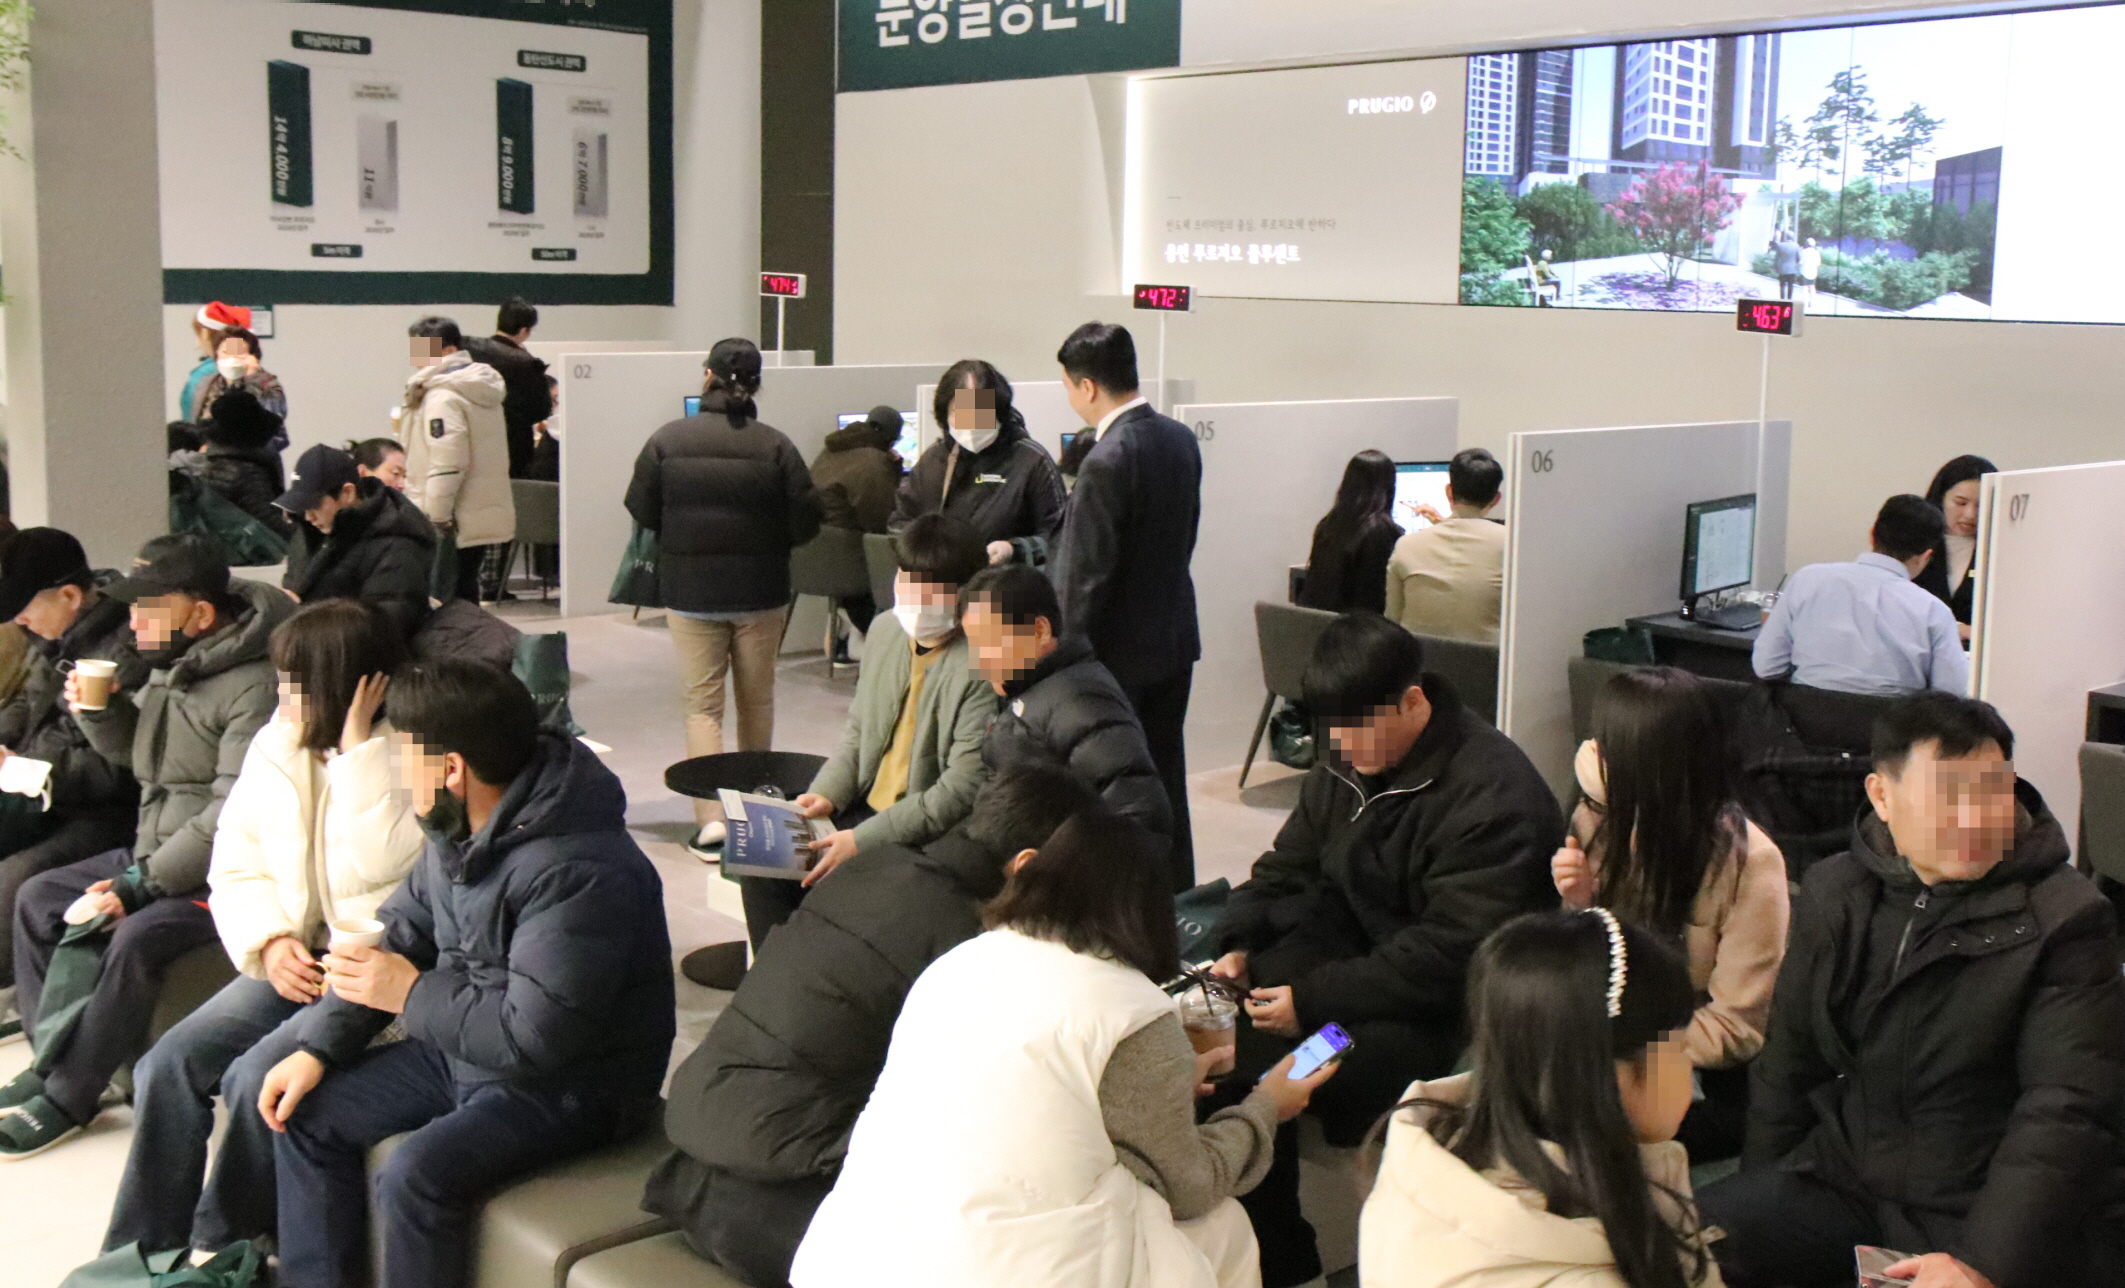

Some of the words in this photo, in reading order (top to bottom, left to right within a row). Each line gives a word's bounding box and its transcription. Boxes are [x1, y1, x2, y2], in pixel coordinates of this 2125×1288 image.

[1347, 96, 1414, 115] PRUGIO
[1192, 243, 1243, 263] 푸르지오
[1148, 287, 1177, 308] 472
[1752, 304, 1781, 330] 463
[573, 364, 592, 379] 02
[1195, 420, 1215, 441] 05
[1531, 449, 1554, 474] 06
[2009, 493, 2030, 521] 07
[1175, 913, 1203, 936] IO
